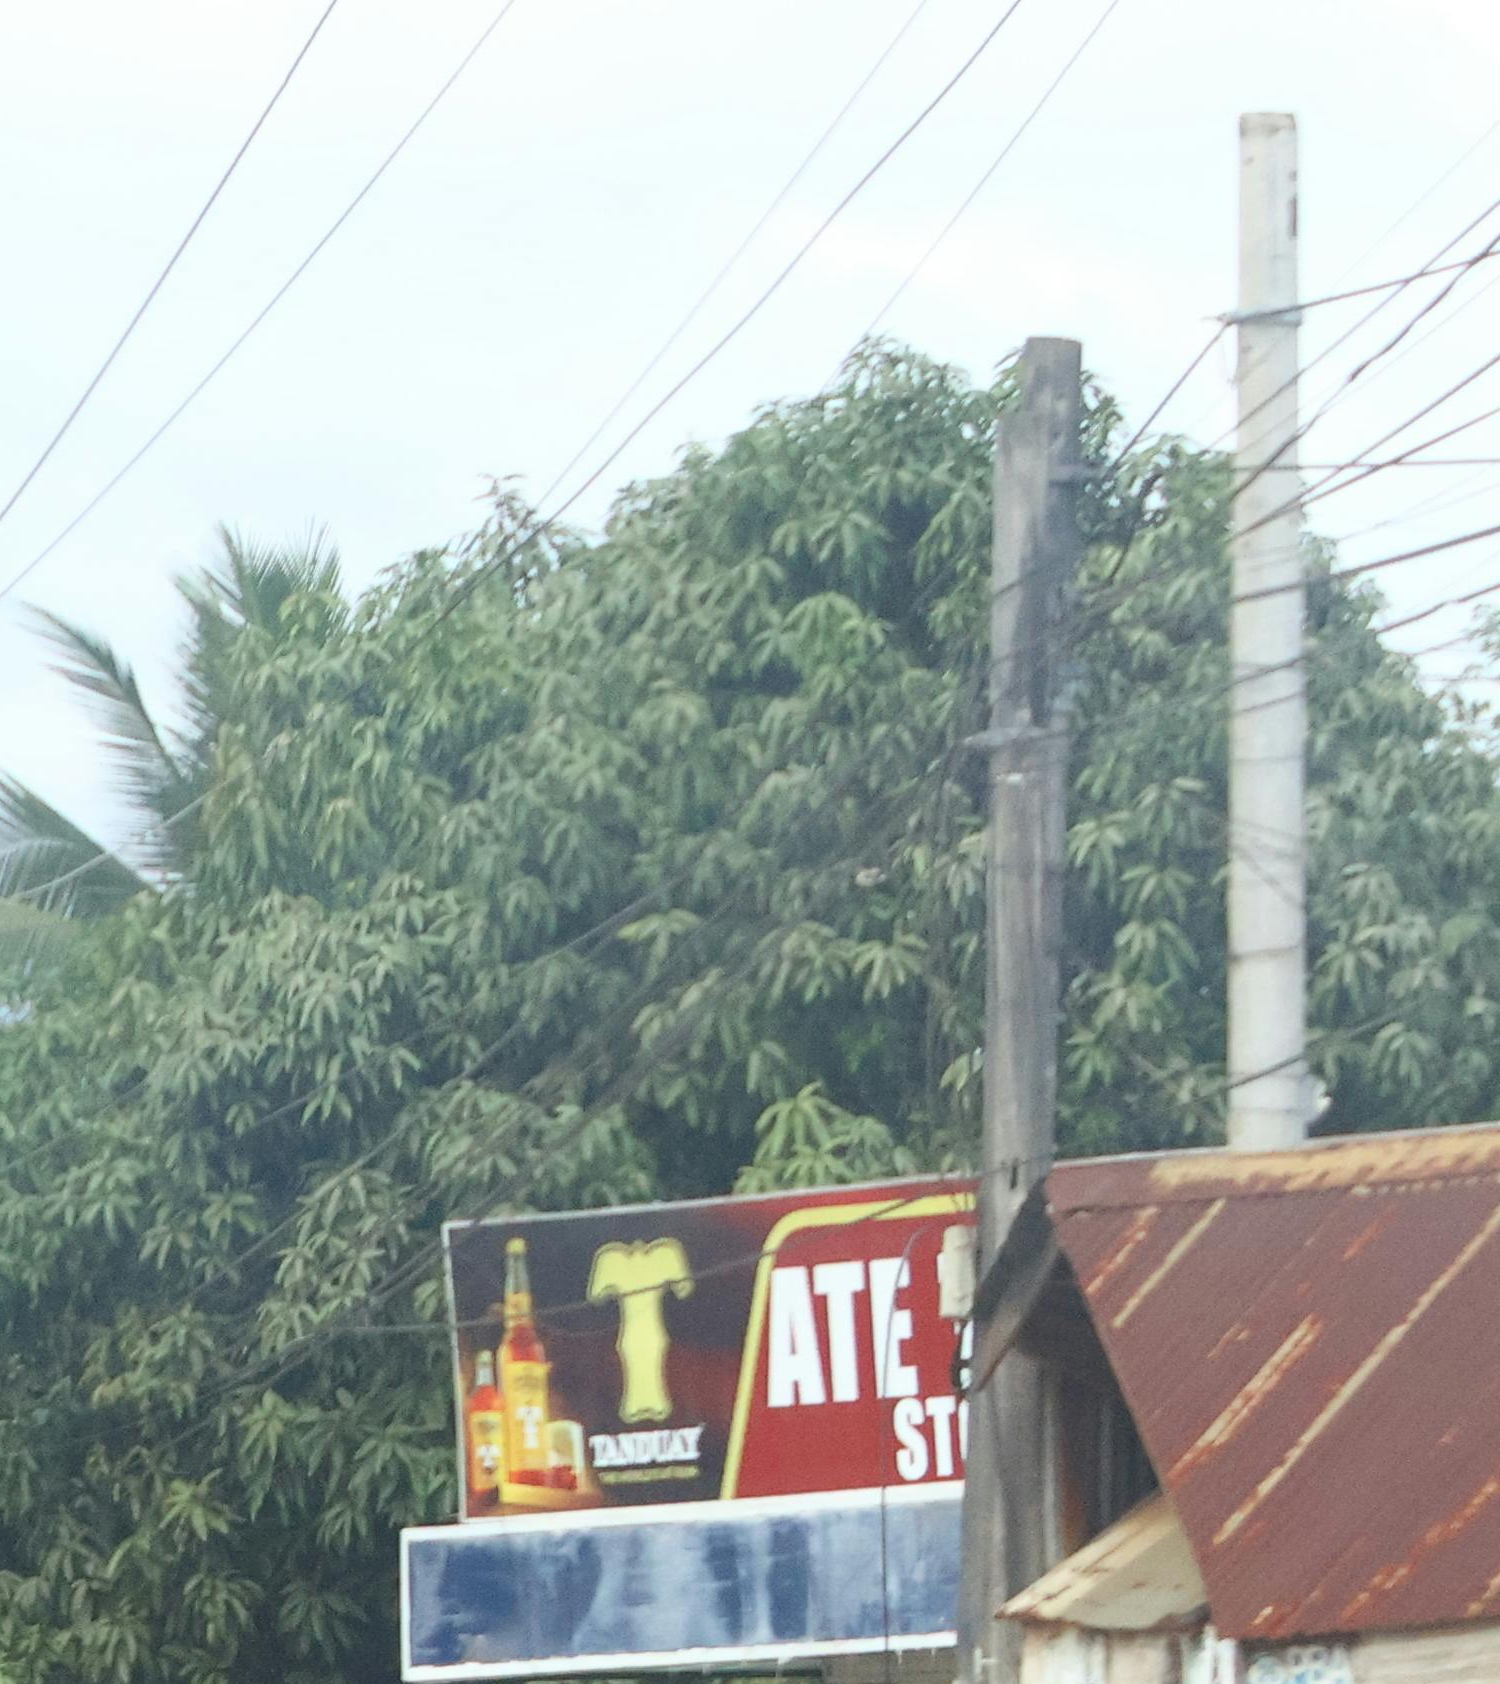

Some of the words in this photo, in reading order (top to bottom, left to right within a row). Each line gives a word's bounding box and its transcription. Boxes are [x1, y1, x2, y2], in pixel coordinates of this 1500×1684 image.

[767, 1257, 919, 1408] ATE
[588, 1423, 705, 1467] TANDUAY
[892, 1396, 970, 1481] ST
